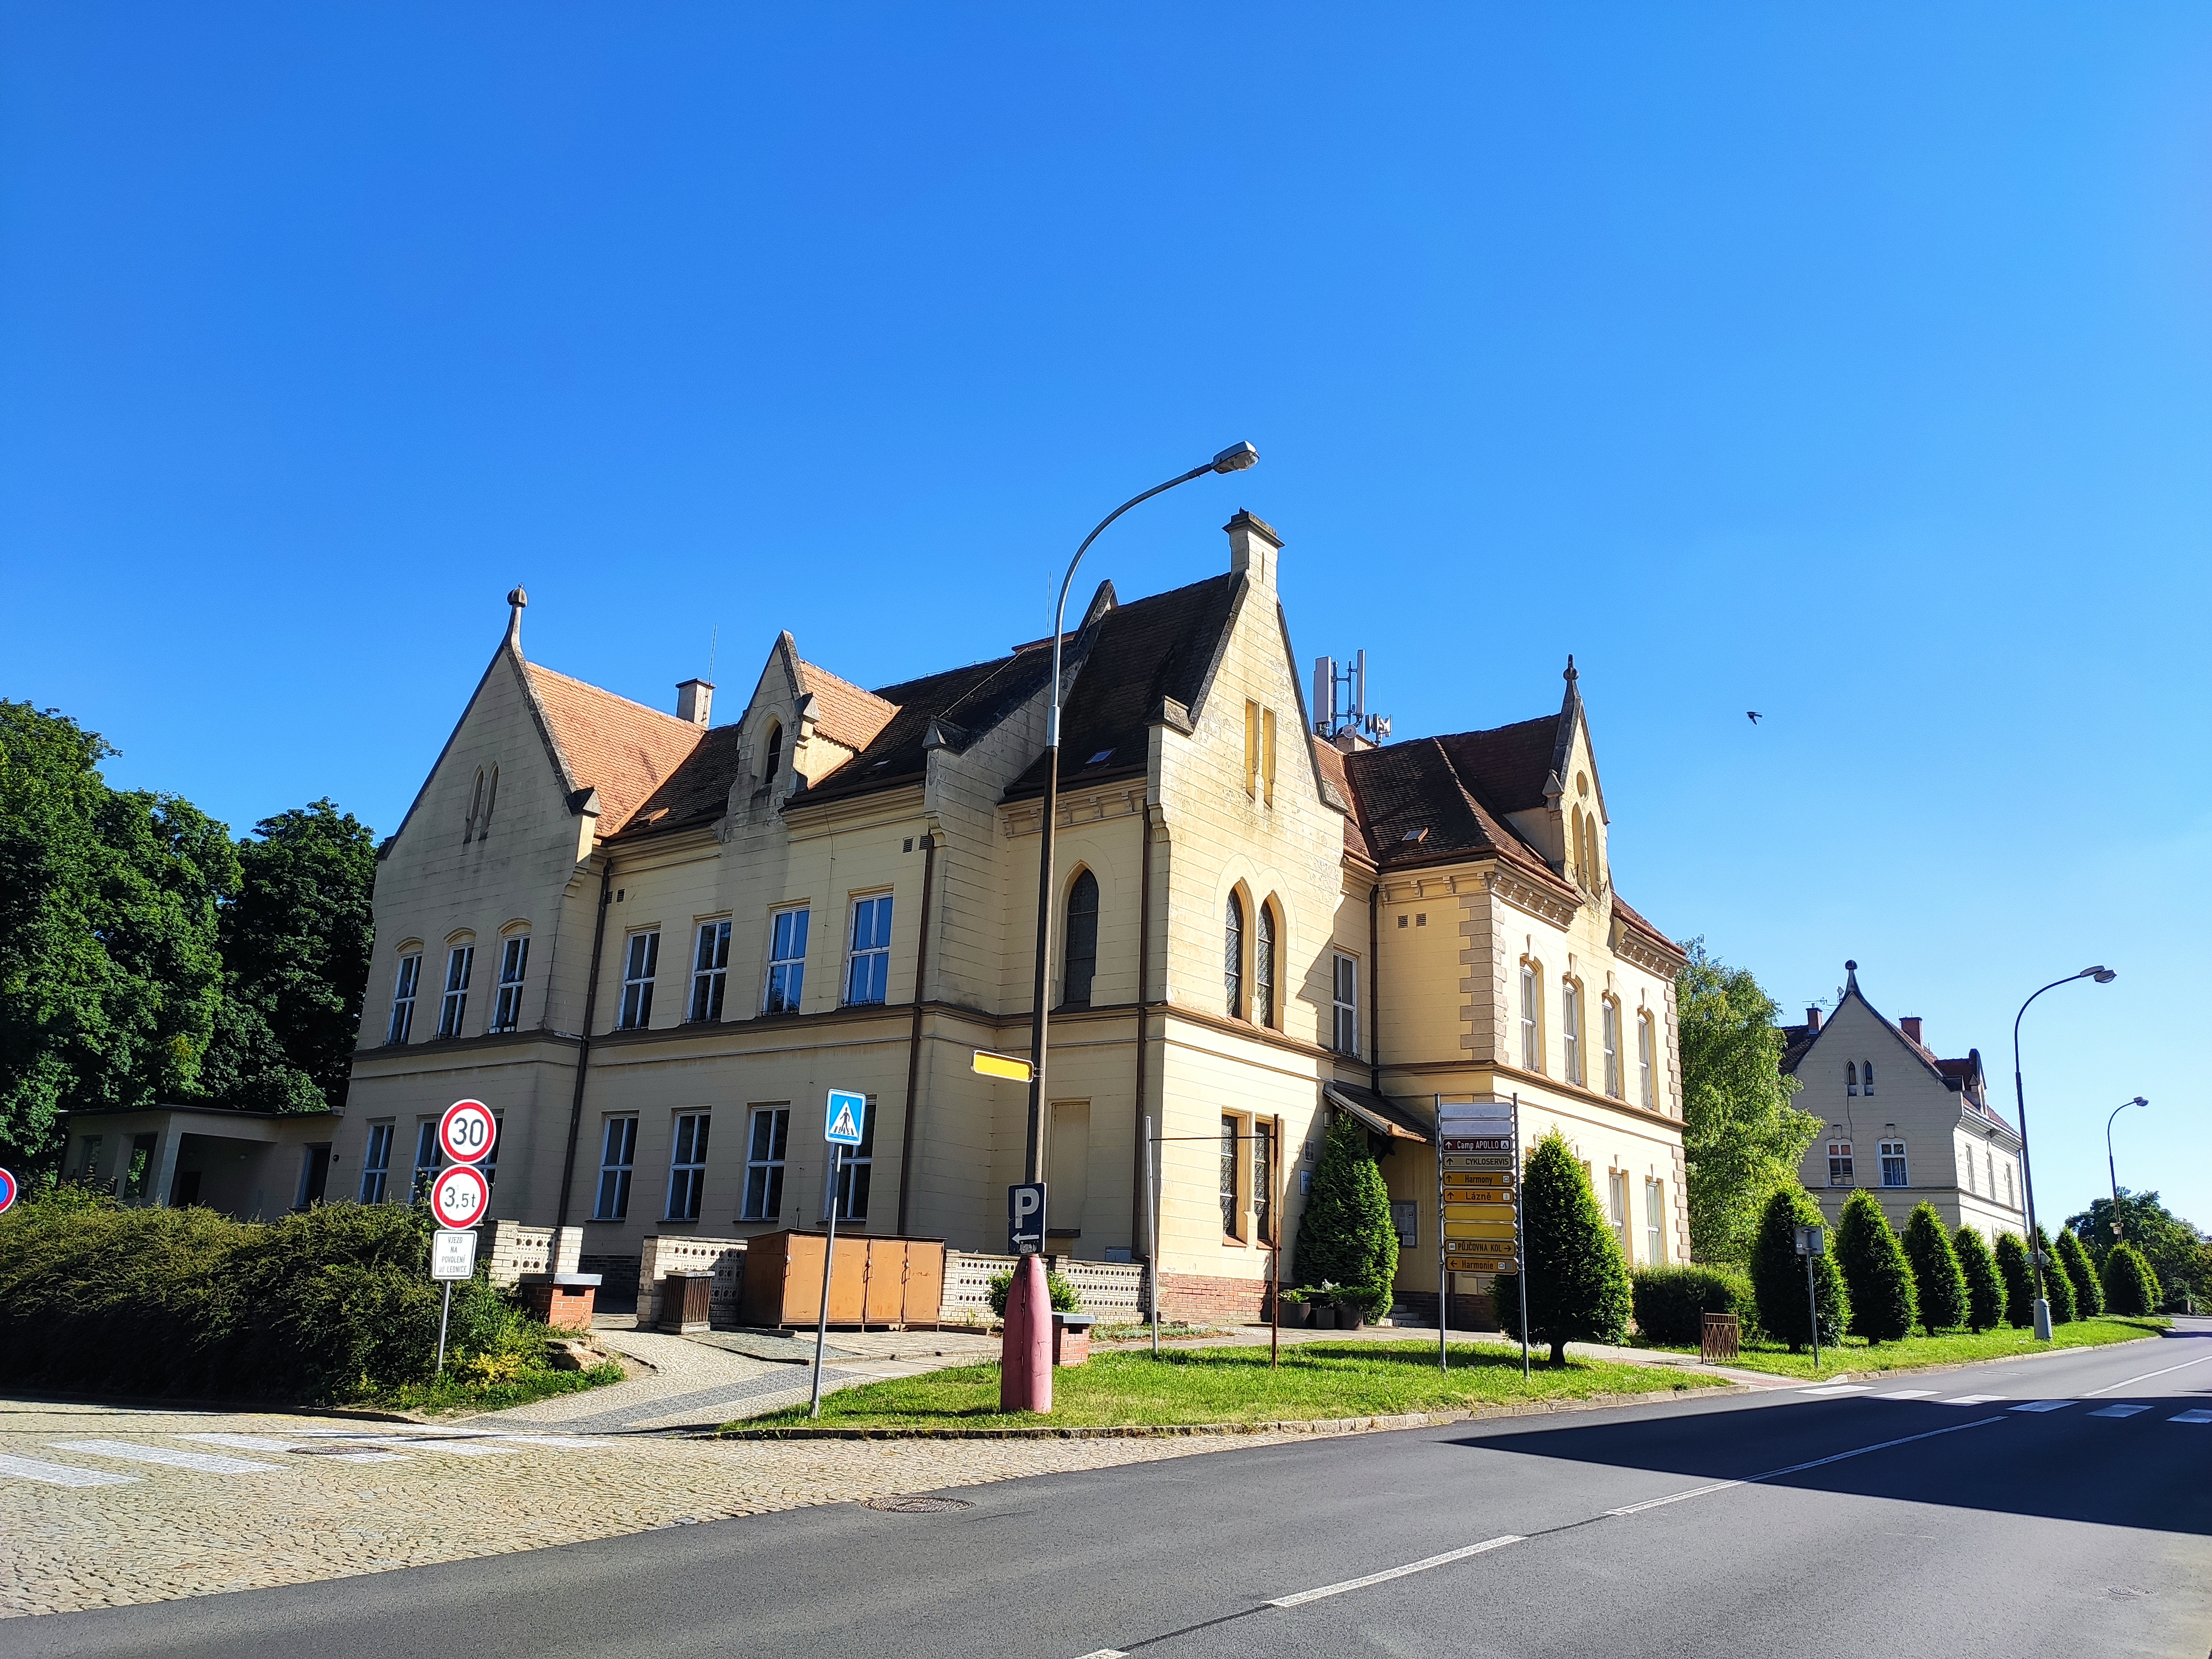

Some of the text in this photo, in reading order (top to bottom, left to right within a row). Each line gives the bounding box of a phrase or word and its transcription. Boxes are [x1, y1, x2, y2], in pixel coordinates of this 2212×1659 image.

[452, 1117, 484, 1147] 30
[1457, 1140, 1499, 1150] Camp APOLLO
[1464, 1175, 1493, 1185] Harmony
[1465, 1192, 1491, 1201] Lázně
[1015, 1188, 1039, 1229] P
[1458, 1241, 1503, 1252] PŮJČOVNA KOL
[442, 1254, 466, 1264] POVOLENÍ
[1462, 1260, 1494, 1270] Harmonie
